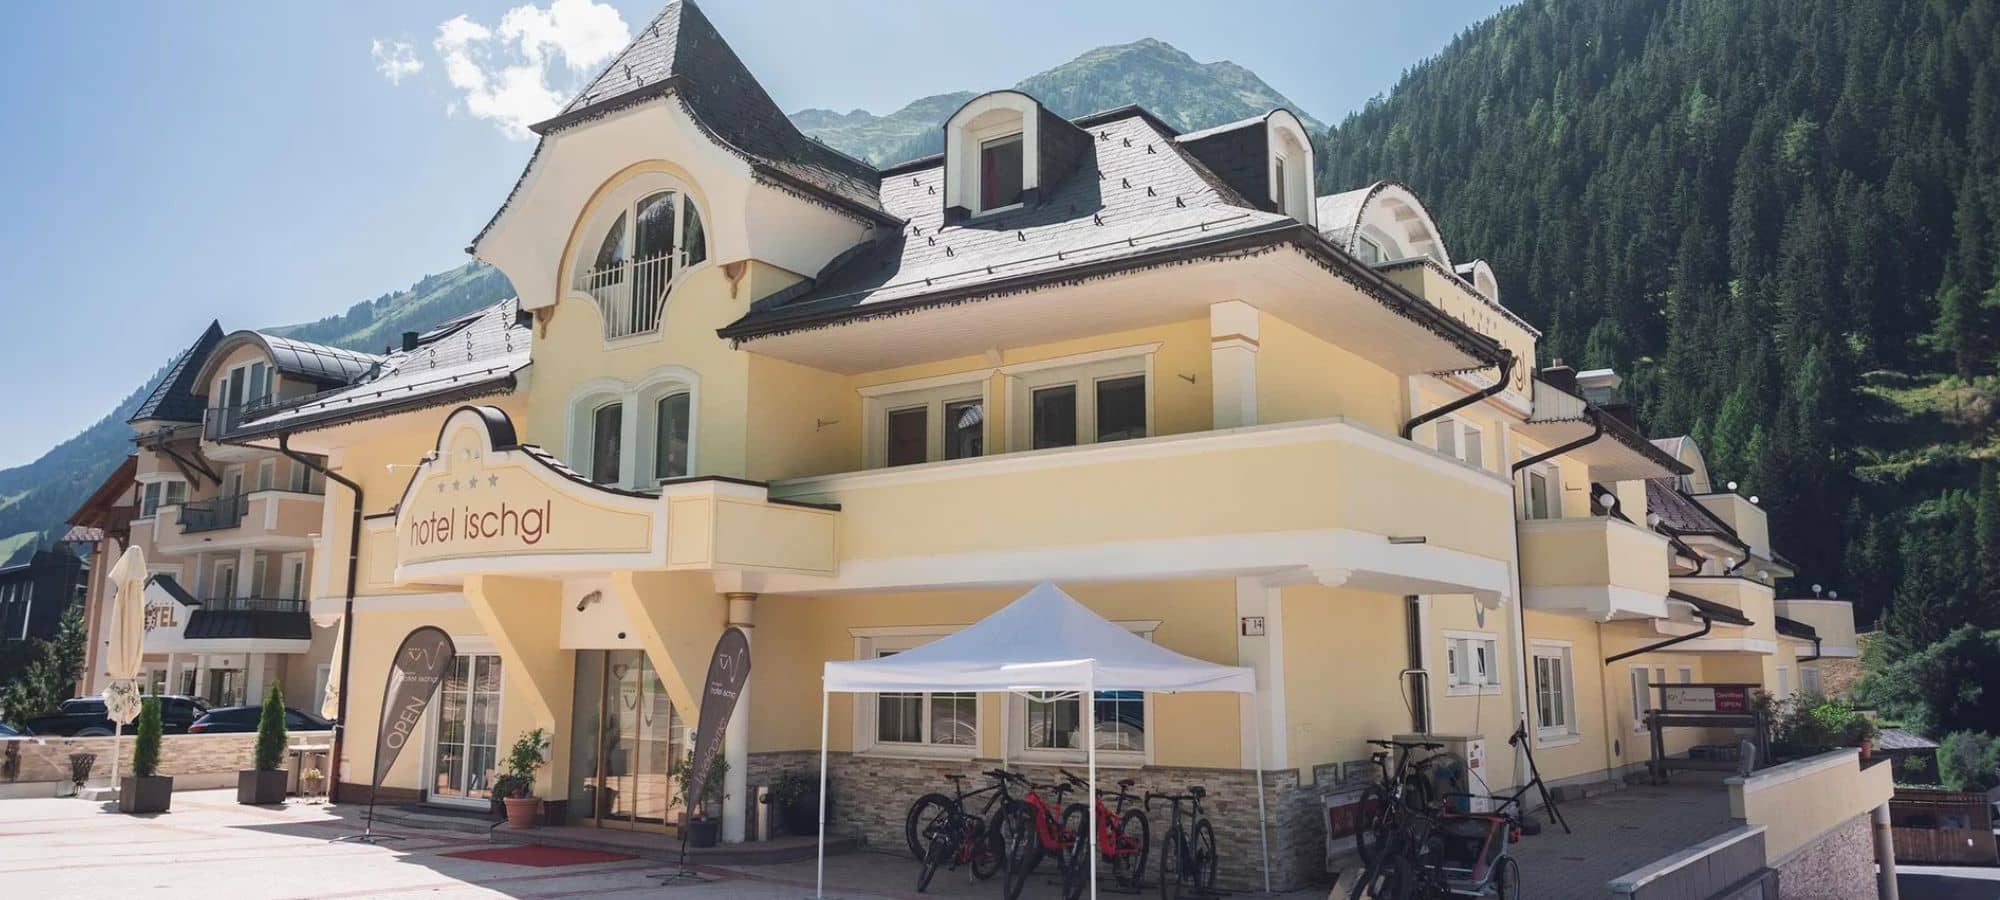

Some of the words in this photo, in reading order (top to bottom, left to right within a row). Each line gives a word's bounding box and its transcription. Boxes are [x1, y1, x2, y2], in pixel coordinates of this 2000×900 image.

[410, 507, 455, 547] hotel
[464, 499, 551, 545] ischgl
[386, 696, 427, 749] OPEN
